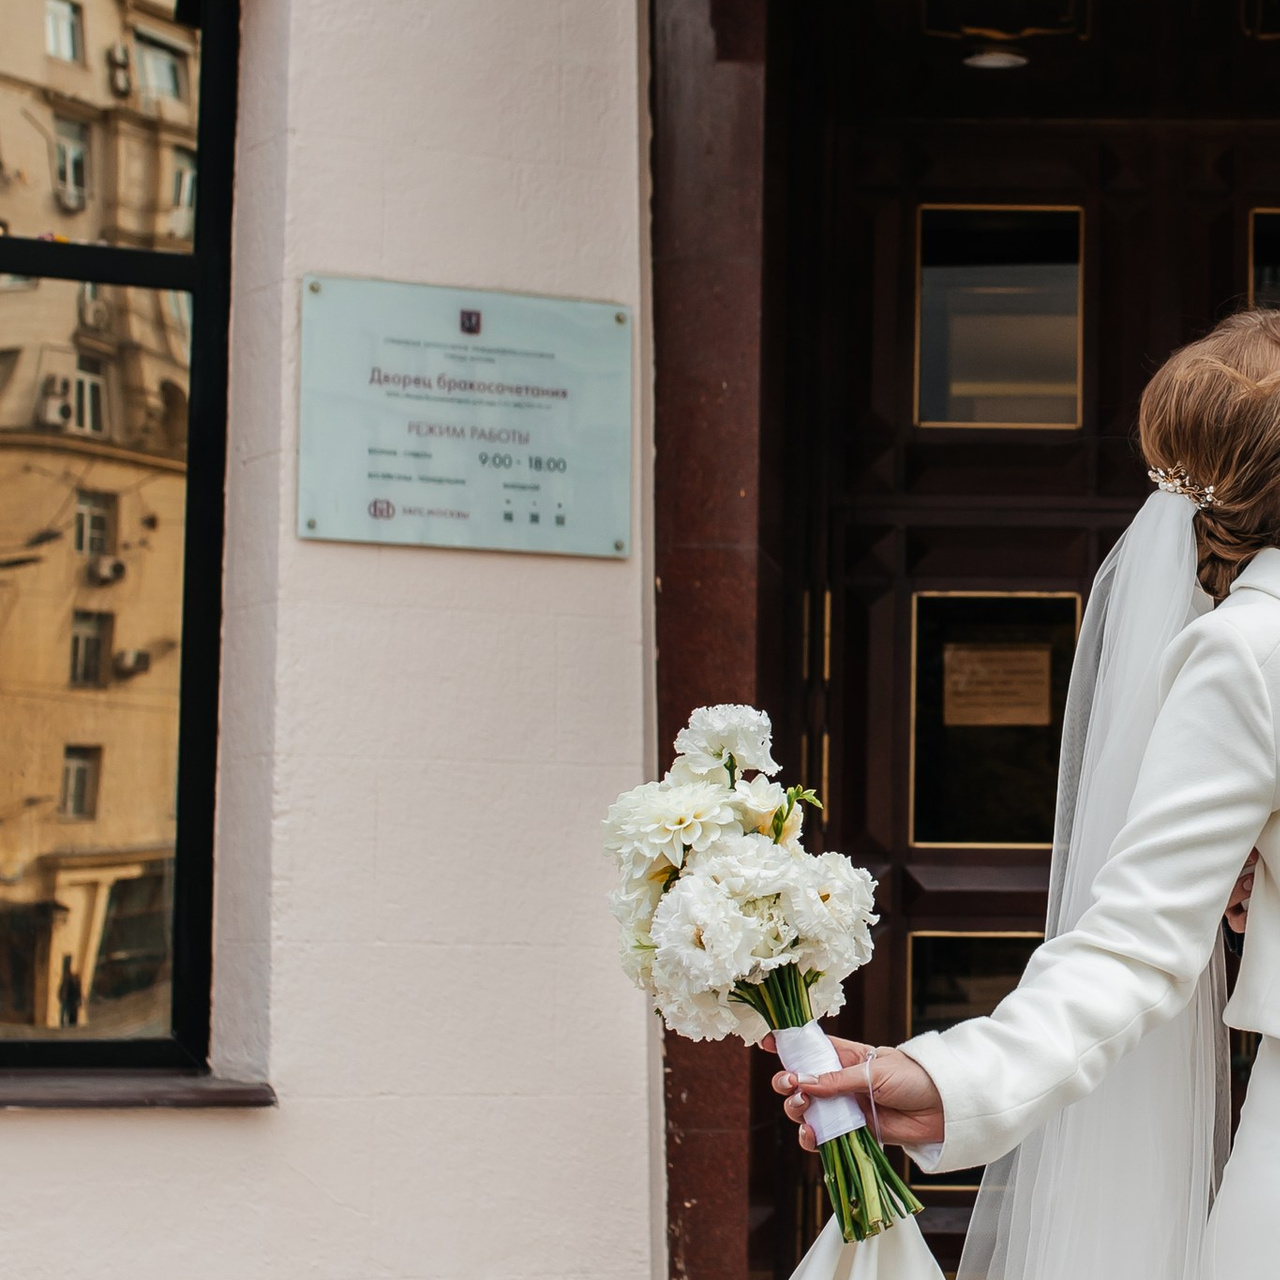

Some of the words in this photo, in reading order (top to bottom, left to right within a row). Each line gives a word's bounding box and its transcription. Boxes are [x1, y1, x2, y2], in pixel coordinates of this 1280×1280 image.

[370, 367, 432, 391] Дворец
[437, 374, 568, 400] бракосочетания
[408, 421, 466, 438] РЕЖИМ
[470, 425, 530, 444] РАБОТЫ
